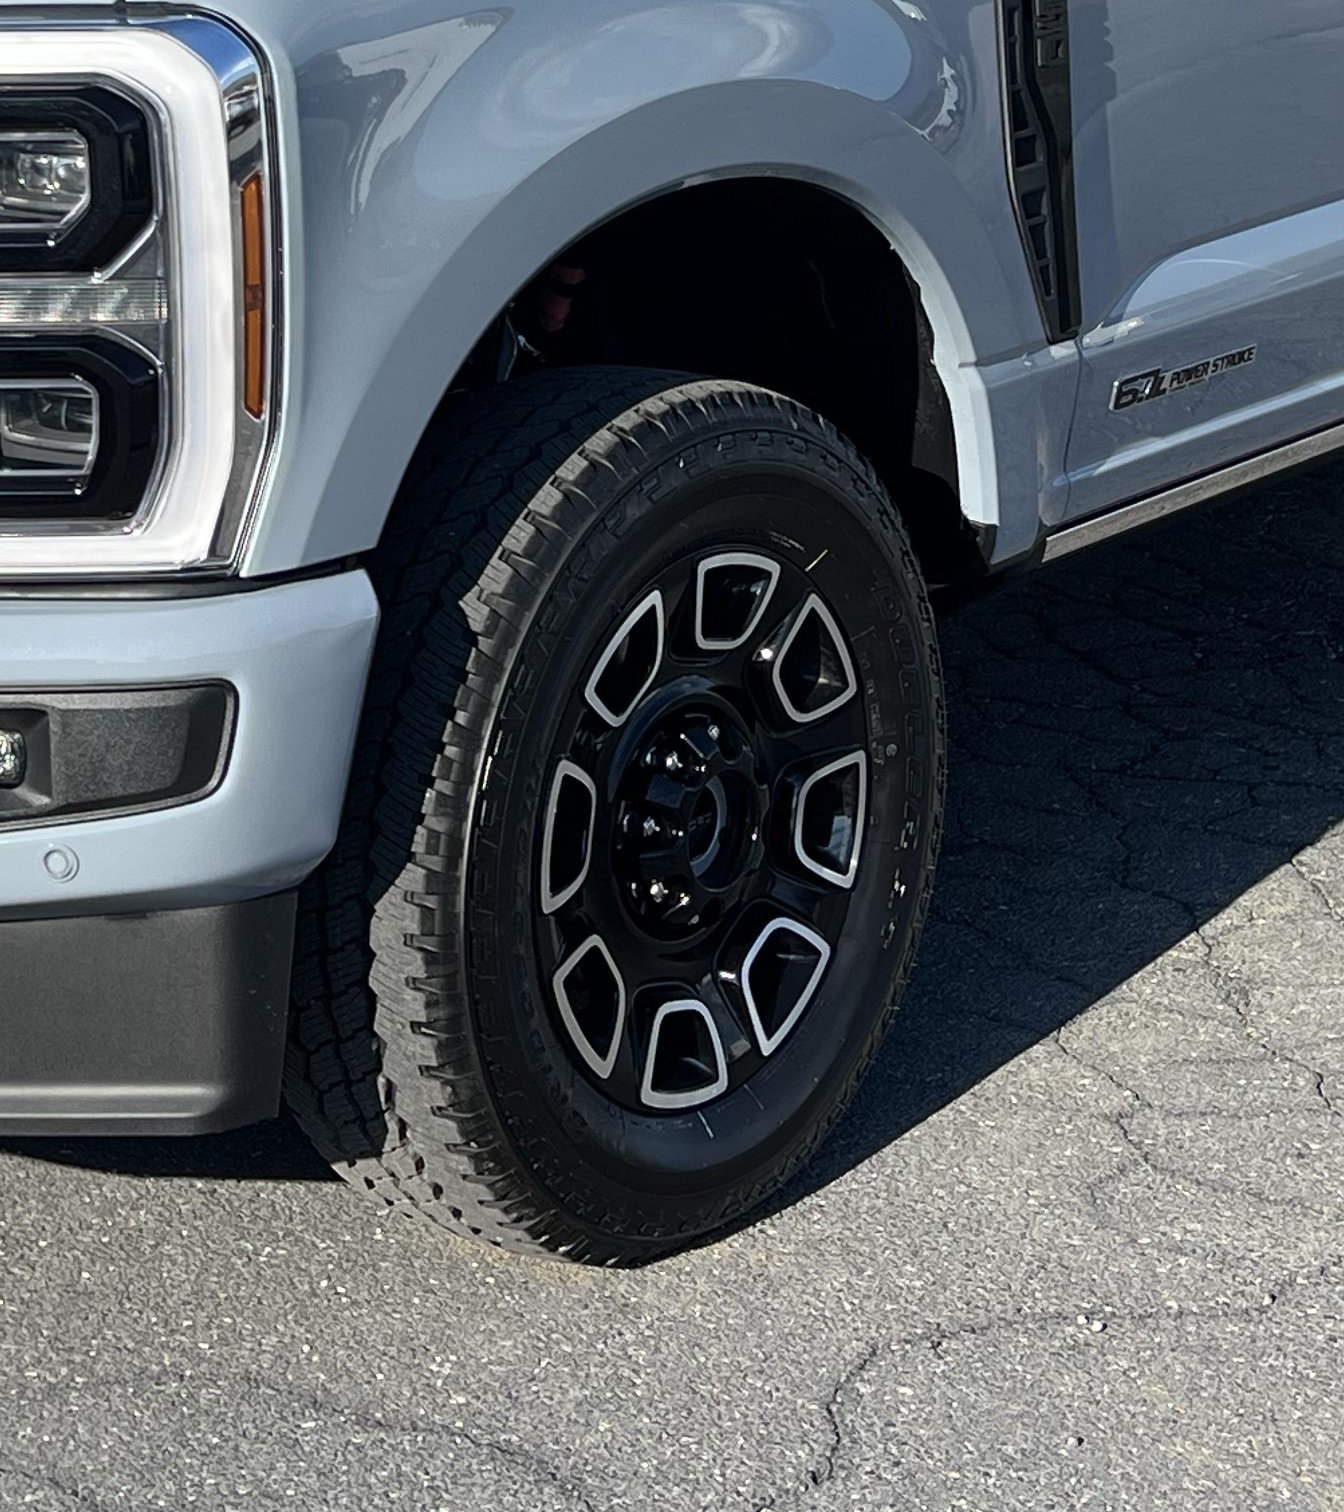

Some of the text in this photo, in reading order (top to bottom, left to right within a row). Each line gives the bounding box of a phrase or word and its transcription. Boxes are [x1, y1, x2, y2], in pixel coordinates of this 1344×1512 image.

[1113, 368, 1168, 410] 6.7L
[1170, 360, 1210, 388] POWER
[1210, 346, 1255, 373] STROKE
